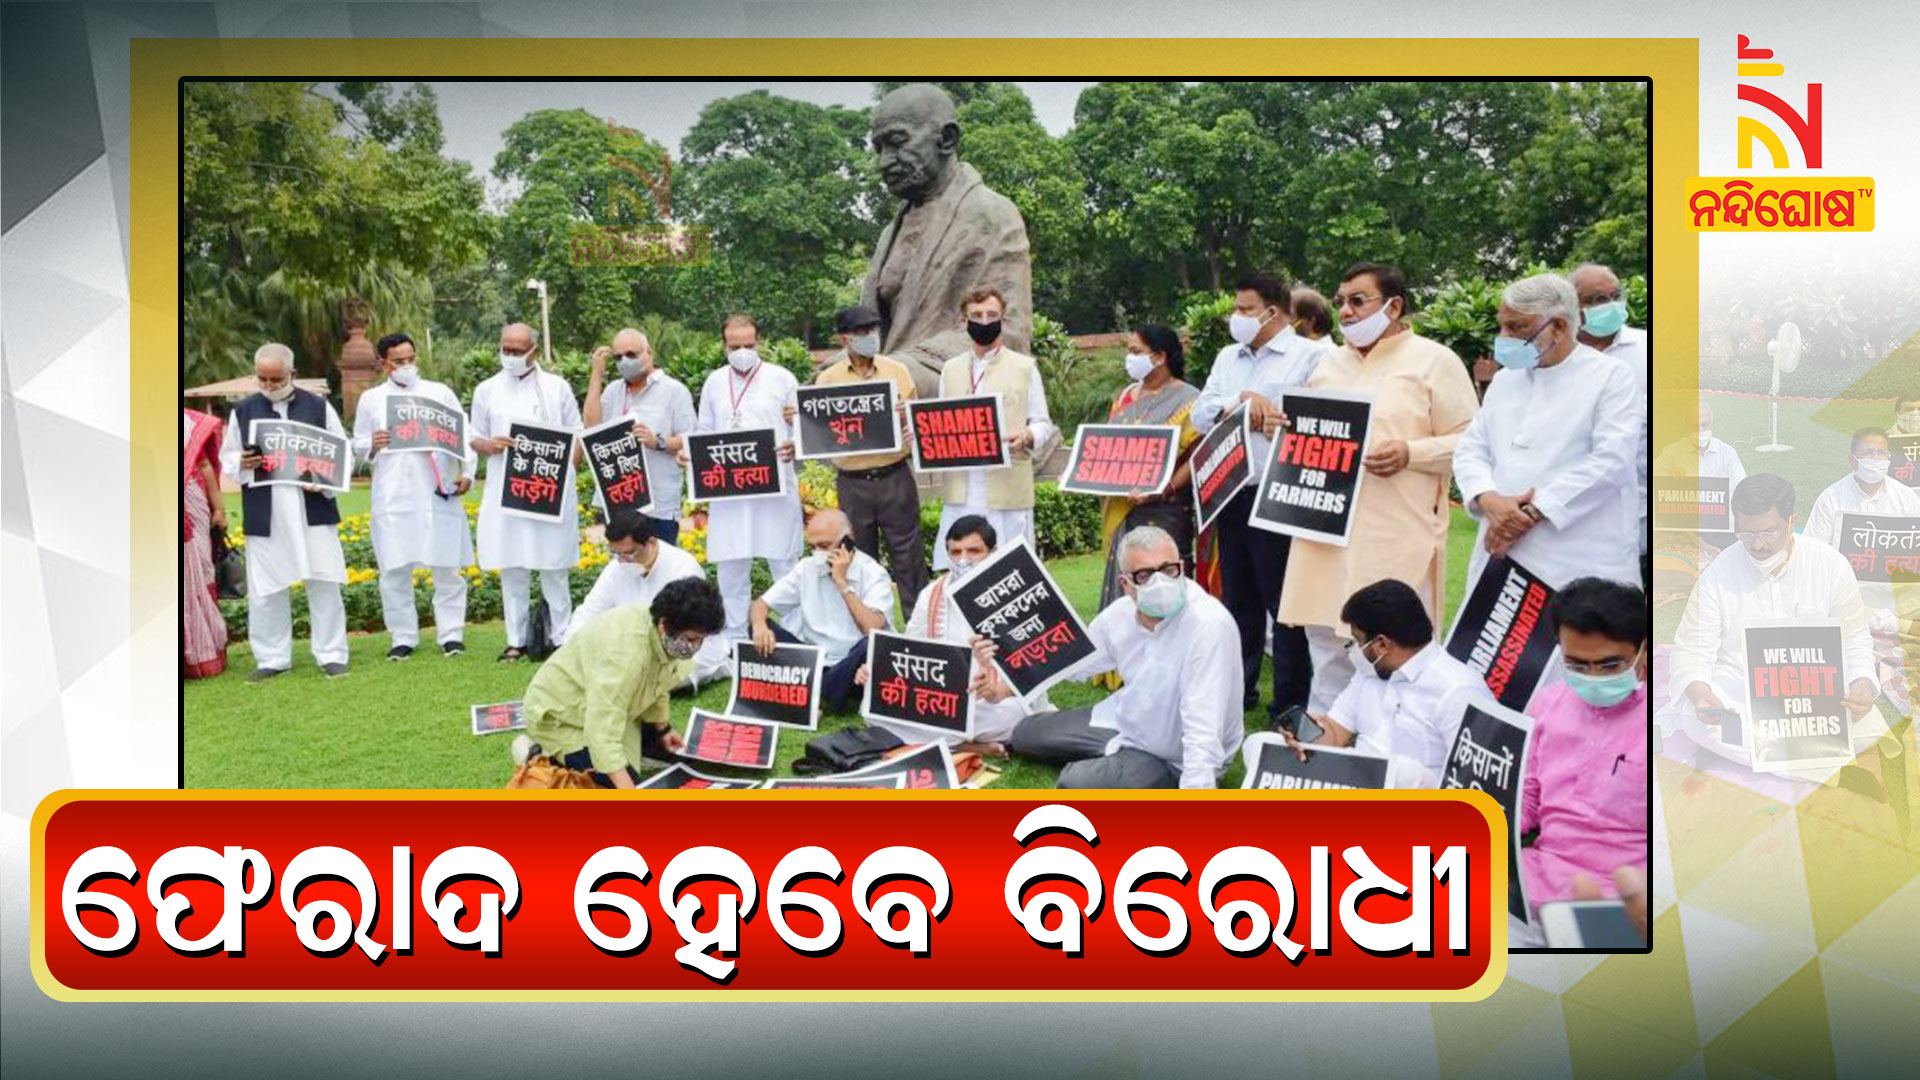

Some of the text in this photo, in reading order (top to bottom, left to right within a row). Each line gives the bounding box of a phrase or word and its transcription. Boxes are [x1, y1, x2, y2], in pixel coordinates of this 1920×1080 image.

[395, 401, 458, 429] लोकतंत्र
[803, 393, 885, 419] গণতন্ত্রের
[829, 415, 863, 445] খুন
[914, 406, 994, 436] SHAME!
[1296, 416, 1351, 439] WE WILL
[264, 427, 338, 459] लोकतंत्र
[514, 433, 566, 460] किसानों
[707, 439, 758, 466] संसद
[920, 431, 997, 461] SHAME!
[1081, 435, 1167, 462] SHAME!
[1278, 433, 1359, 473] FIGHT
[513, 453, 561, 480] के लिए
[600, 453, 641, 480] के लिए
[701, 463, 772, 490] की हत्या
[1074, 459, 1163, 487] SHAME!
[1300, 469, 1327, 487] FOR
[1894, 461, 1915, 481] की
[1268, 481, 1346, 514] FARMERS
[1658, 490, 1725, 503] PARLIAMENT
[1848, 549, 1878, 573] की
[974, 568, 1026, 608] আমরা
[976, 581, 1050, 639] কৃষকদের
[1467, 567, 1528, 675] ARLIAMENT
[1007, 614, 1046, 642] জন্য
[1487, 581, 1548, 700] SSASSINATED
[890, 648, 948, 687] संसद
[1763, 647, 1826, 664] WE WILL
[740, 661, 810, 685] DEMOCRACY
[1754, 666, 1838, 698] FIGHT
[879, 676, 958, 718] की हत्या
[1784, 698, 1812, 714] FOR
[1759, 716, 1841, 738] FARMERS
[1453, 727, 1514, 790] किसानों
